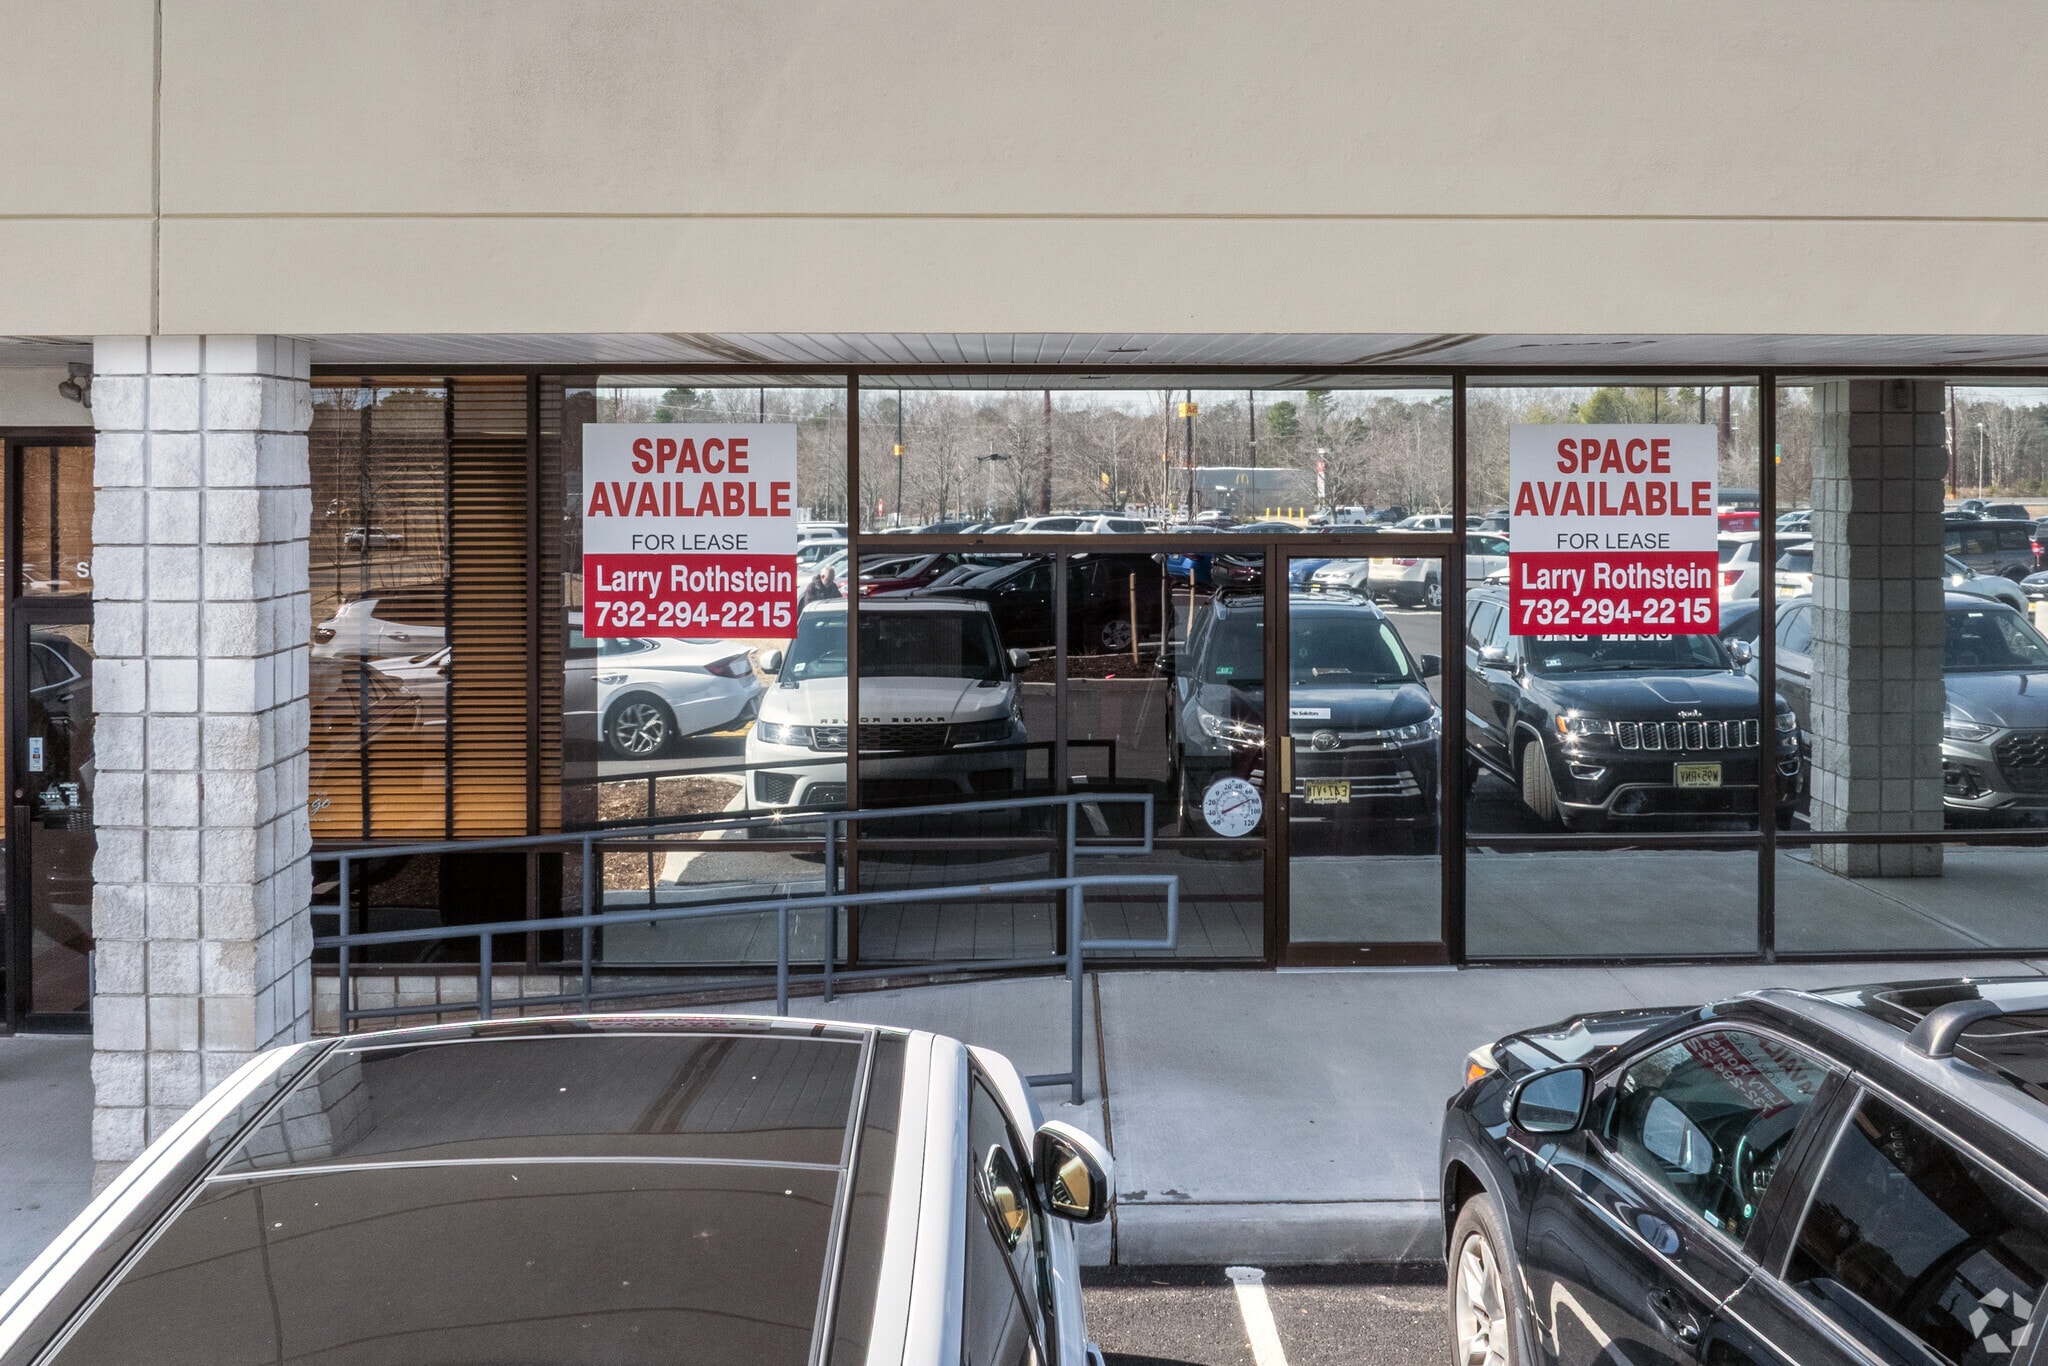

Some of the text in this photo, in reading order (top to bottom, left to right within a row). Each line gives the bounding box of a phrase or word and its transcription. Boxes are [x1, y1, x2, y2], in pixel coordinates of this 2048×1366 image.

[631, 437, 749, 474] SPACE
[1556, 437, 1671, 474] SPACE
[587, 481, 792, 518] AVAILABLE
[1513, 481, 1712, 517] AVAILABLE
[631, 534, 749, 551] FOR LEASE
[1556, 532, 1671, 550] FOR LEASE
[596, 564, 792, 599] Larry Rothstein
[1521, 562, 1712, 597] Larry Rothstein
[594, 600, 792, 628] 732-294-2215
[1519, 597, 1712, 625] 732-294-2215
